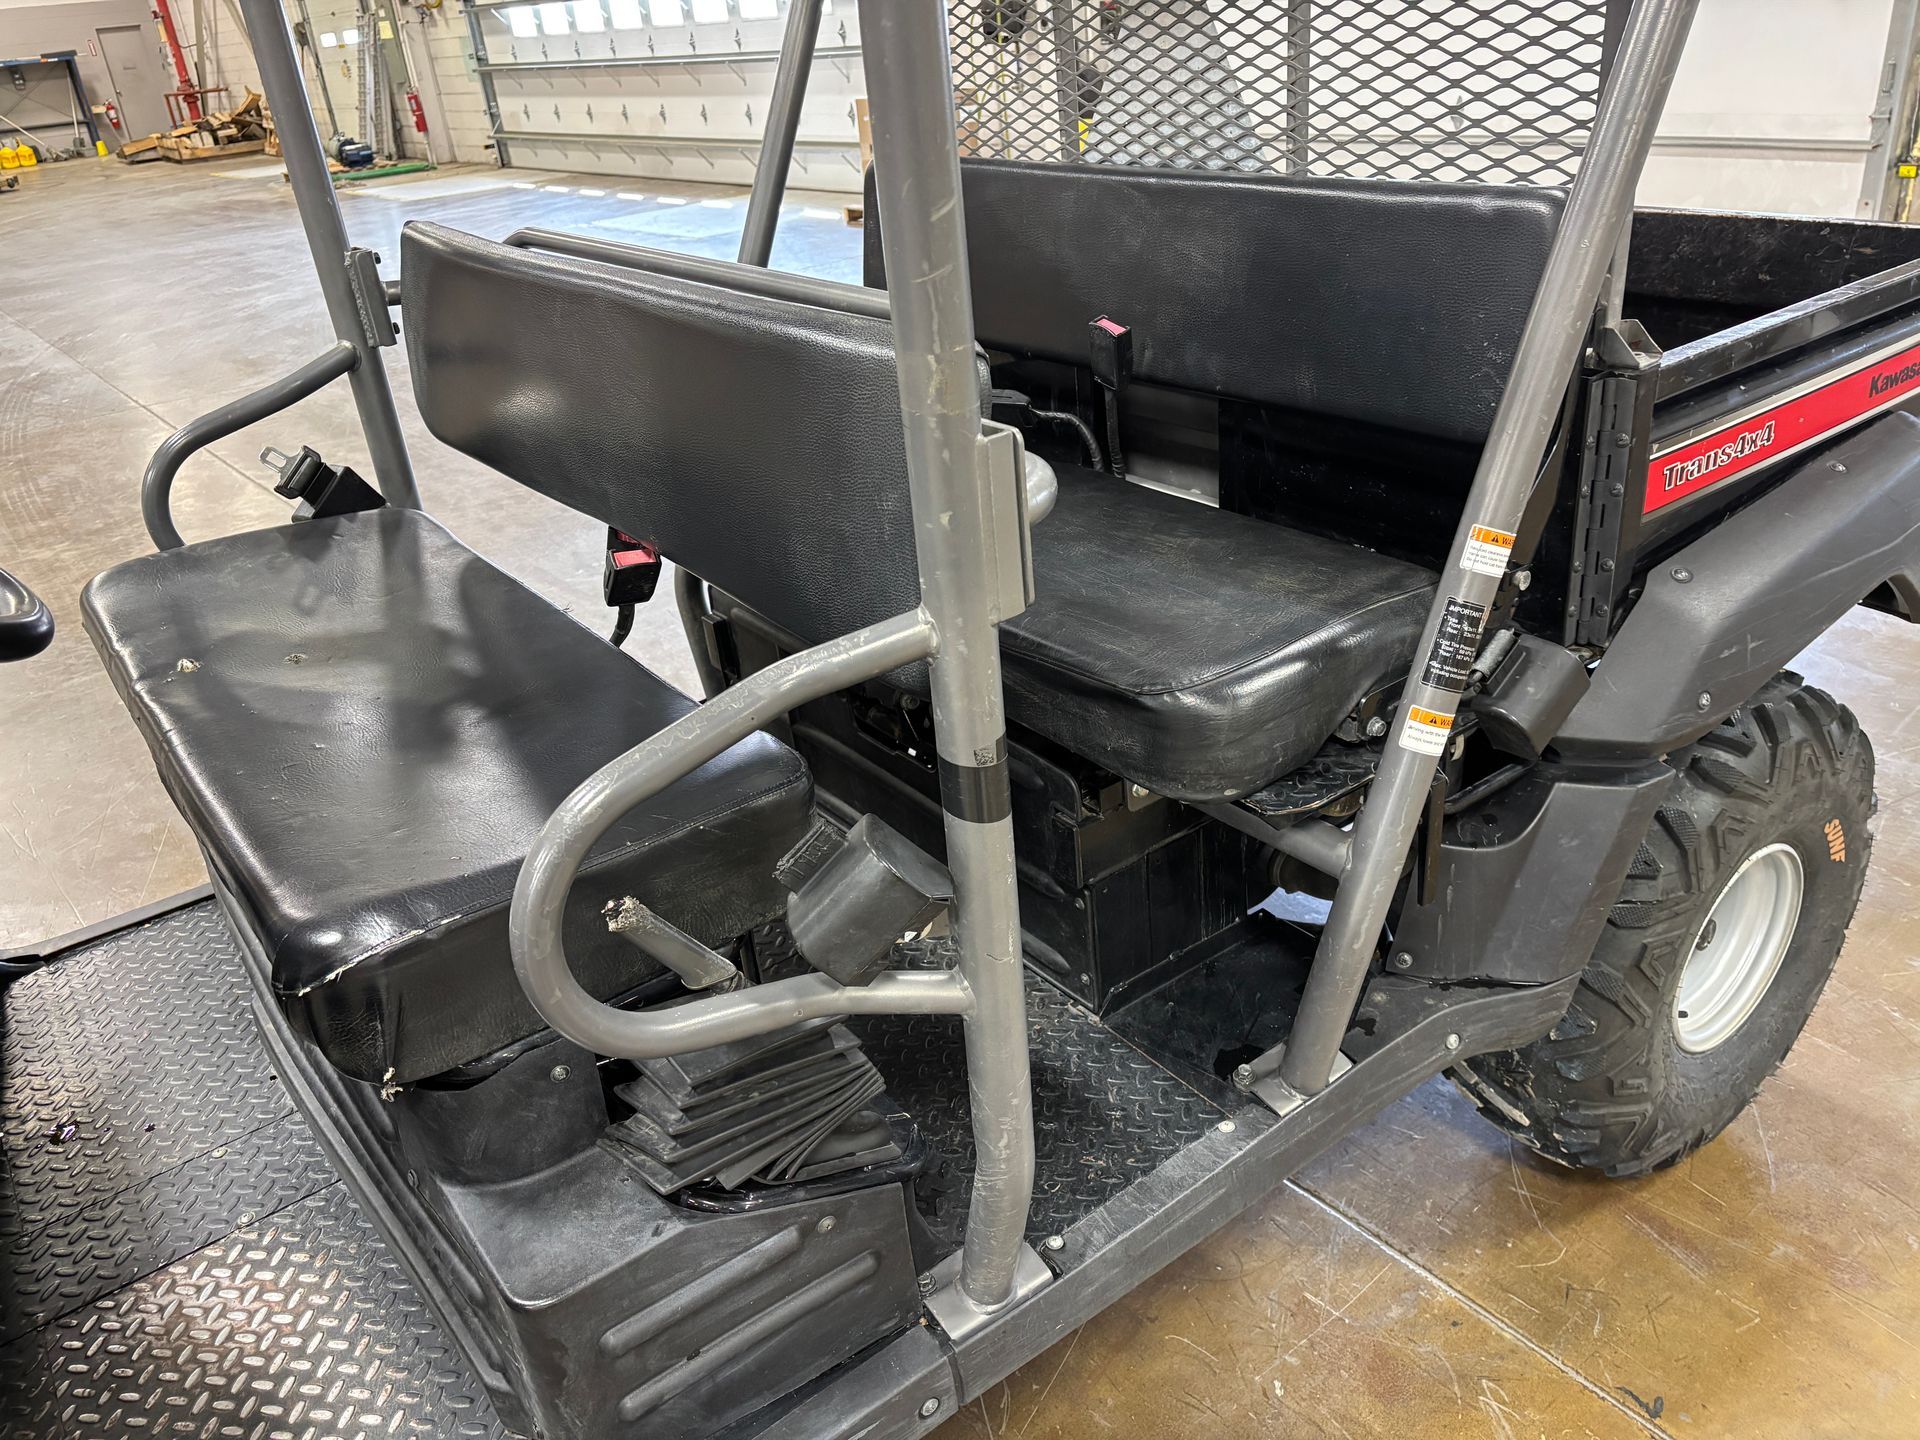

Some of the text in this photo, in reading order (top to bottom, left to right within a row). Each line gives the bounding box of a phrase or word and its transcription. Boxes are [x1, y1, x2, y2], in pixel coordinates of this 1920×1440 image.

[1663, 420, 1776, 491] Trans4x4
[1449, 605, 1482, 617] IMPORTANT
[1440, 638, 1450, 646] Cold
